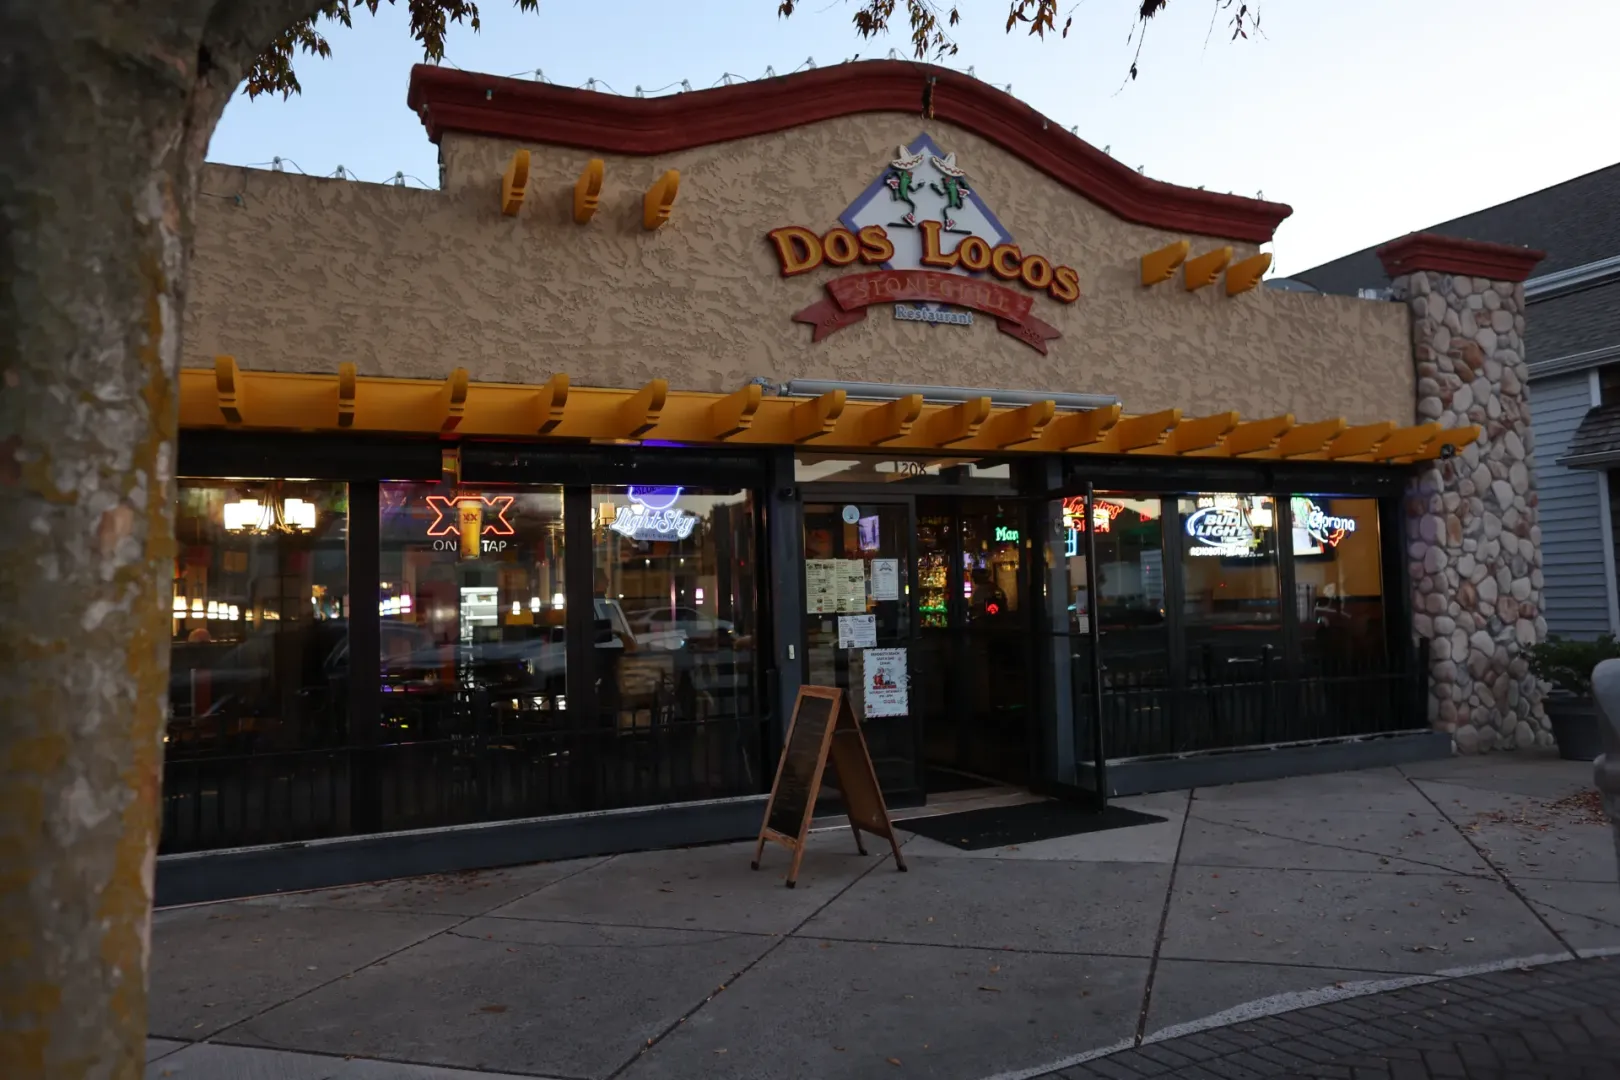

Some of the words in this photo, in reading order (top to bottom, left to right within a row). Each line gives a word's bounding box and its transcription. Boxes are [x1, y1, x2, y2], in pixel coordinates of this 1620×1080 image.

[768, 225, 895, 278] DOS
[919, 220, 1080, 303] LOCOS
[895, 304, 974, 325] Restaurant
[900, 462, 927, 477] 208
[1204, 514, 1239, 526] BUD
[1309, 511, 1355, 532] Corona
[1196, 525, 1247, 536] LIGHT
[433, 540, 457, 551] ON
[481, 540, 507, 552] TAP
